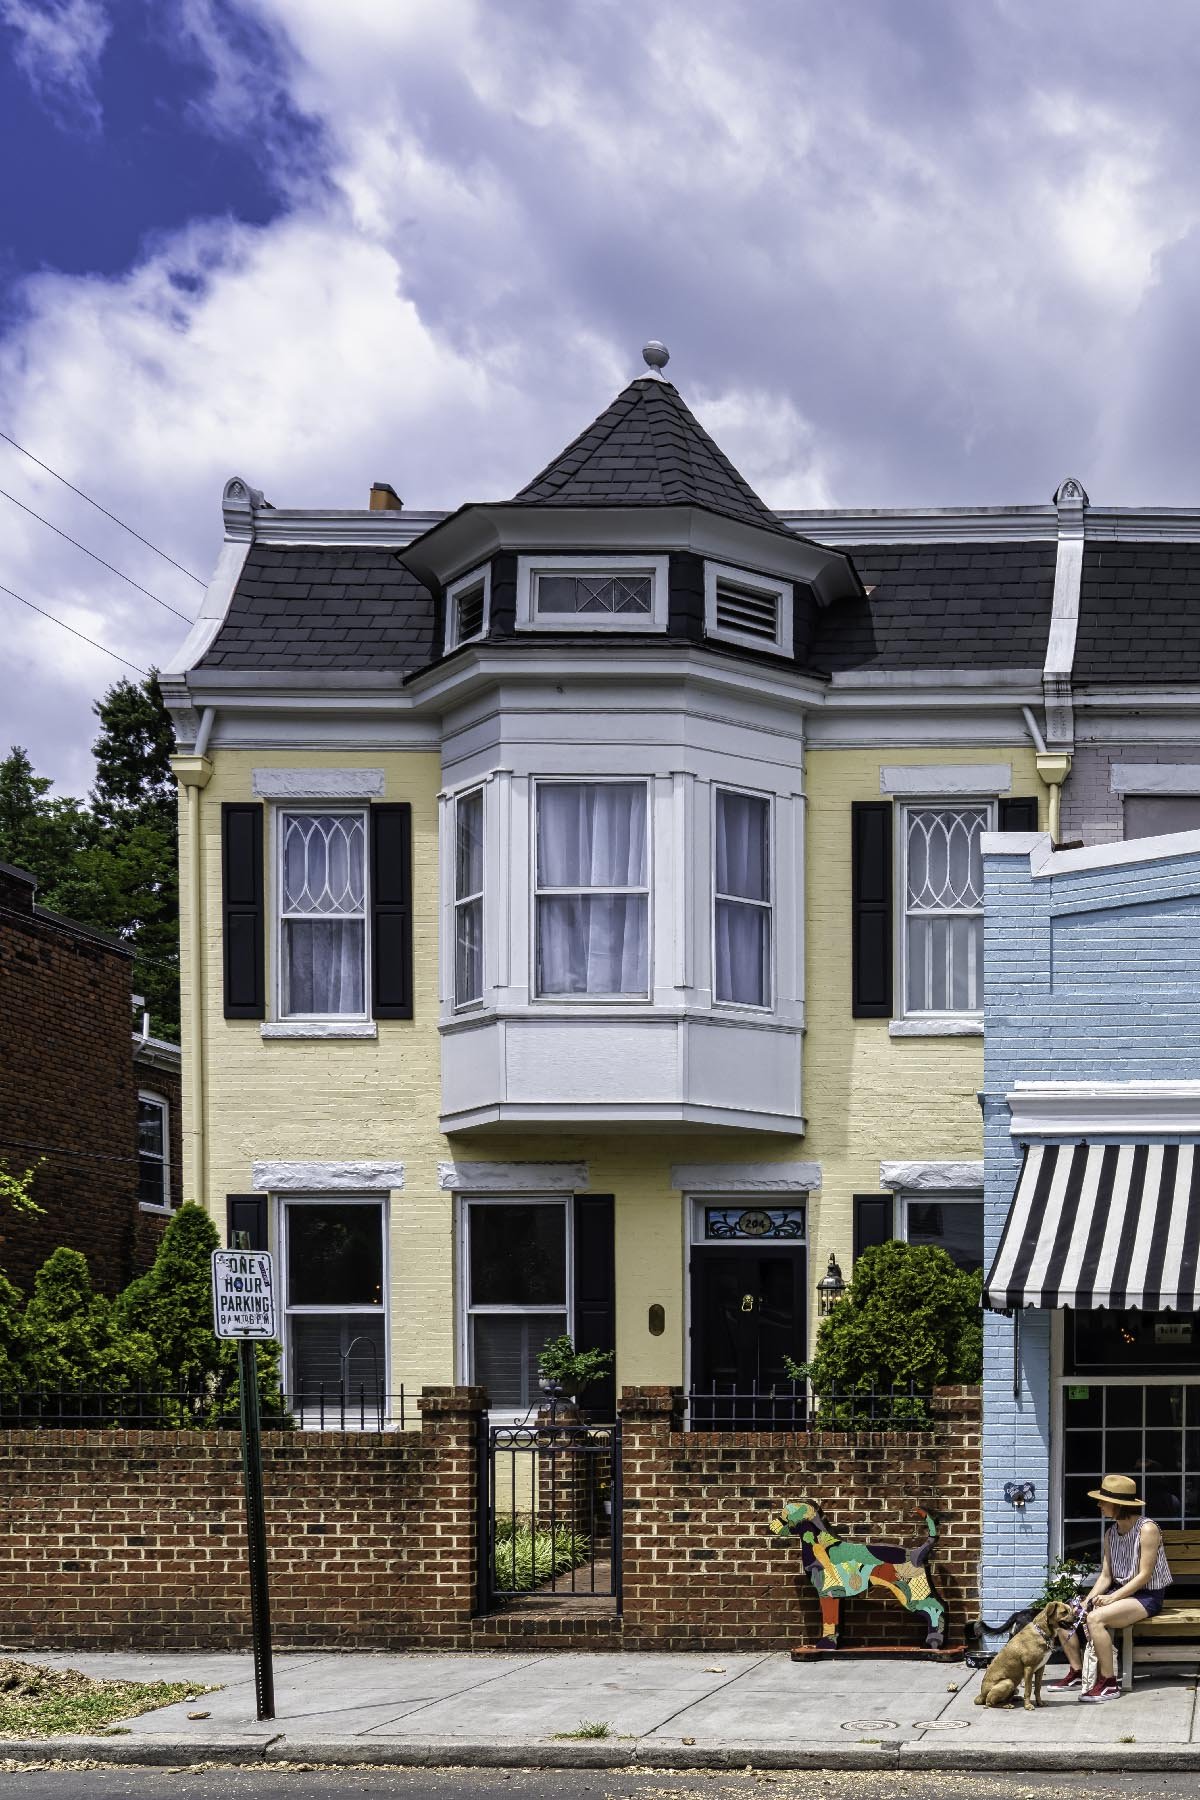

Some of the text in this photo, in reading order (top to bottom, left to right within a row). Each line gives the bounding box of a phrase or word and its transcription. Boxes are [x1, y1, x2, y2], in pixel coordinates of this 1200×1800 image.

[230, 1258, 255, 1274] ONE
[225, 1277, 262, 1293] HOUR
[221, 1296, 269, 1312] PARKING
